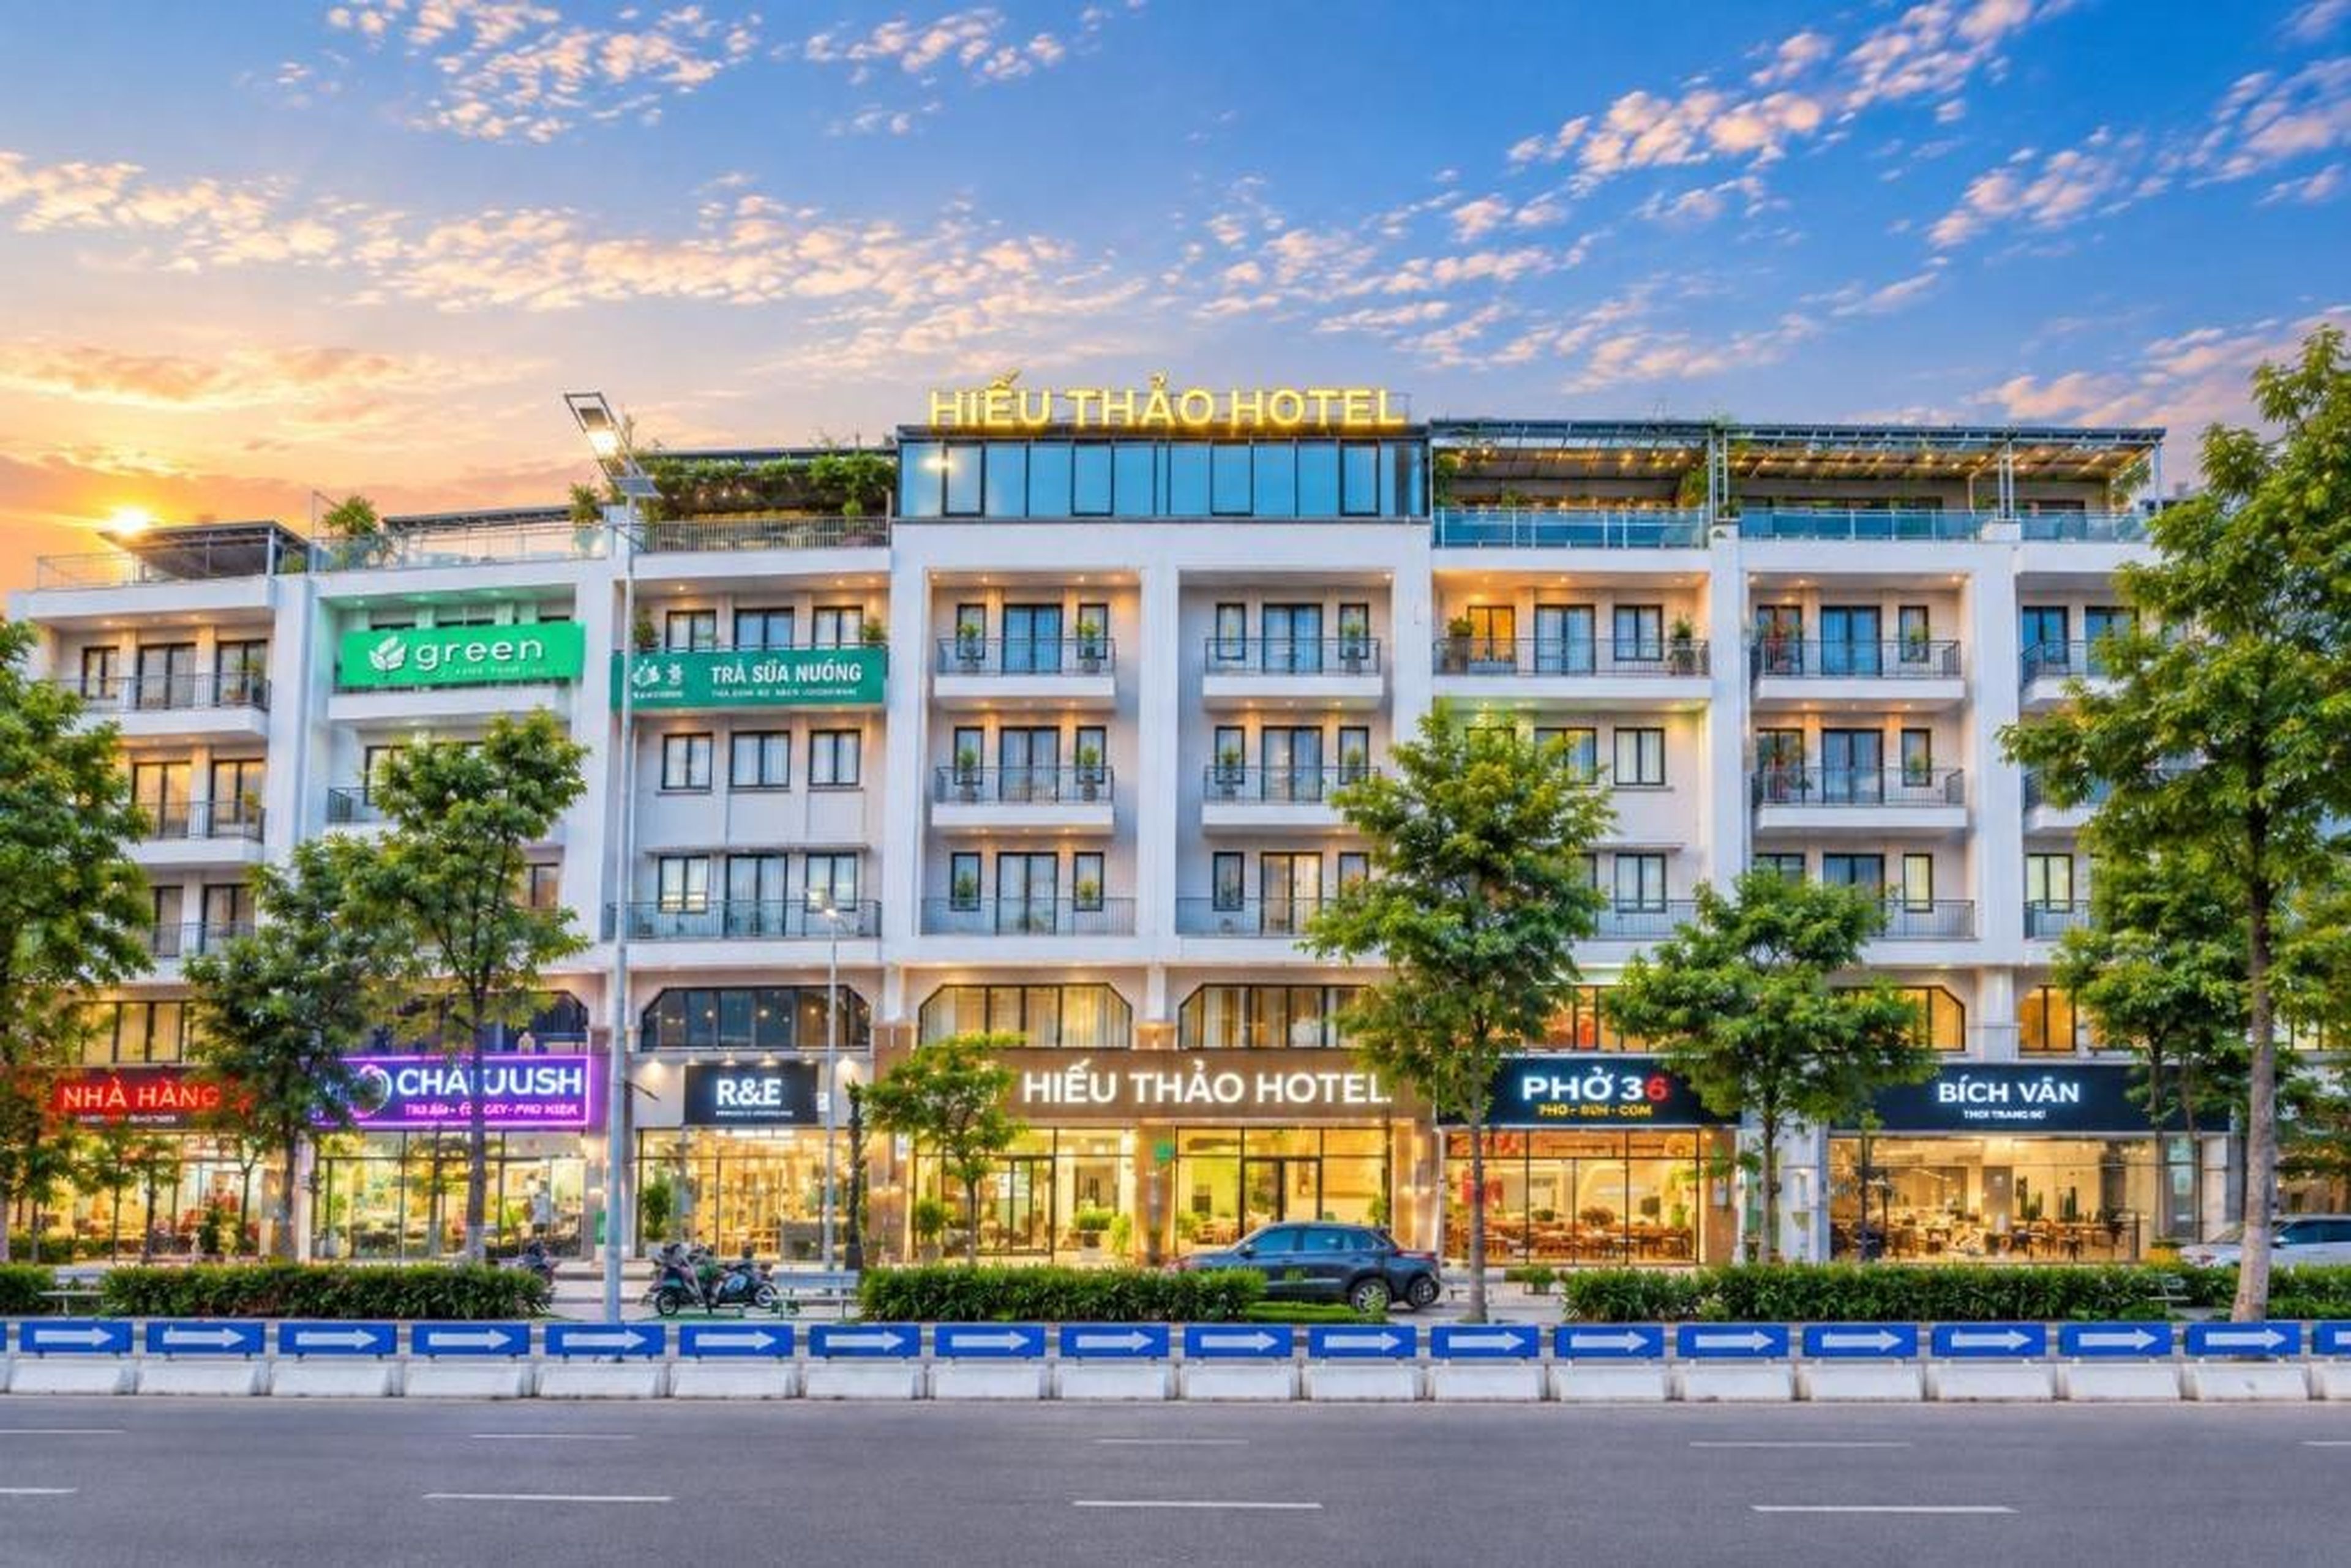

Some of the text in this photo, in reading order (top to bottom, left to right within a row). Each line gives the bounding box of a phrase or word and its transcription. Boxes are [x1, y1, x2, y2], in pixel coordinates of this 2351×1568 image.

[931, 369, 1406, 427] HIẾU THẢO HOTEL
[416, 639, 544, 671] green
[63, 1076, 220, 1108] NHÀ HÀNG
[716, 1078, 782, 1106] R&E
[1024, 1057, 1392, 1103] HIẾU THẢO HOTEL
[1523, 1067, 1668, 1101] PHỞ 36
[1938, 1075, 2009, 1103] BÍCH
